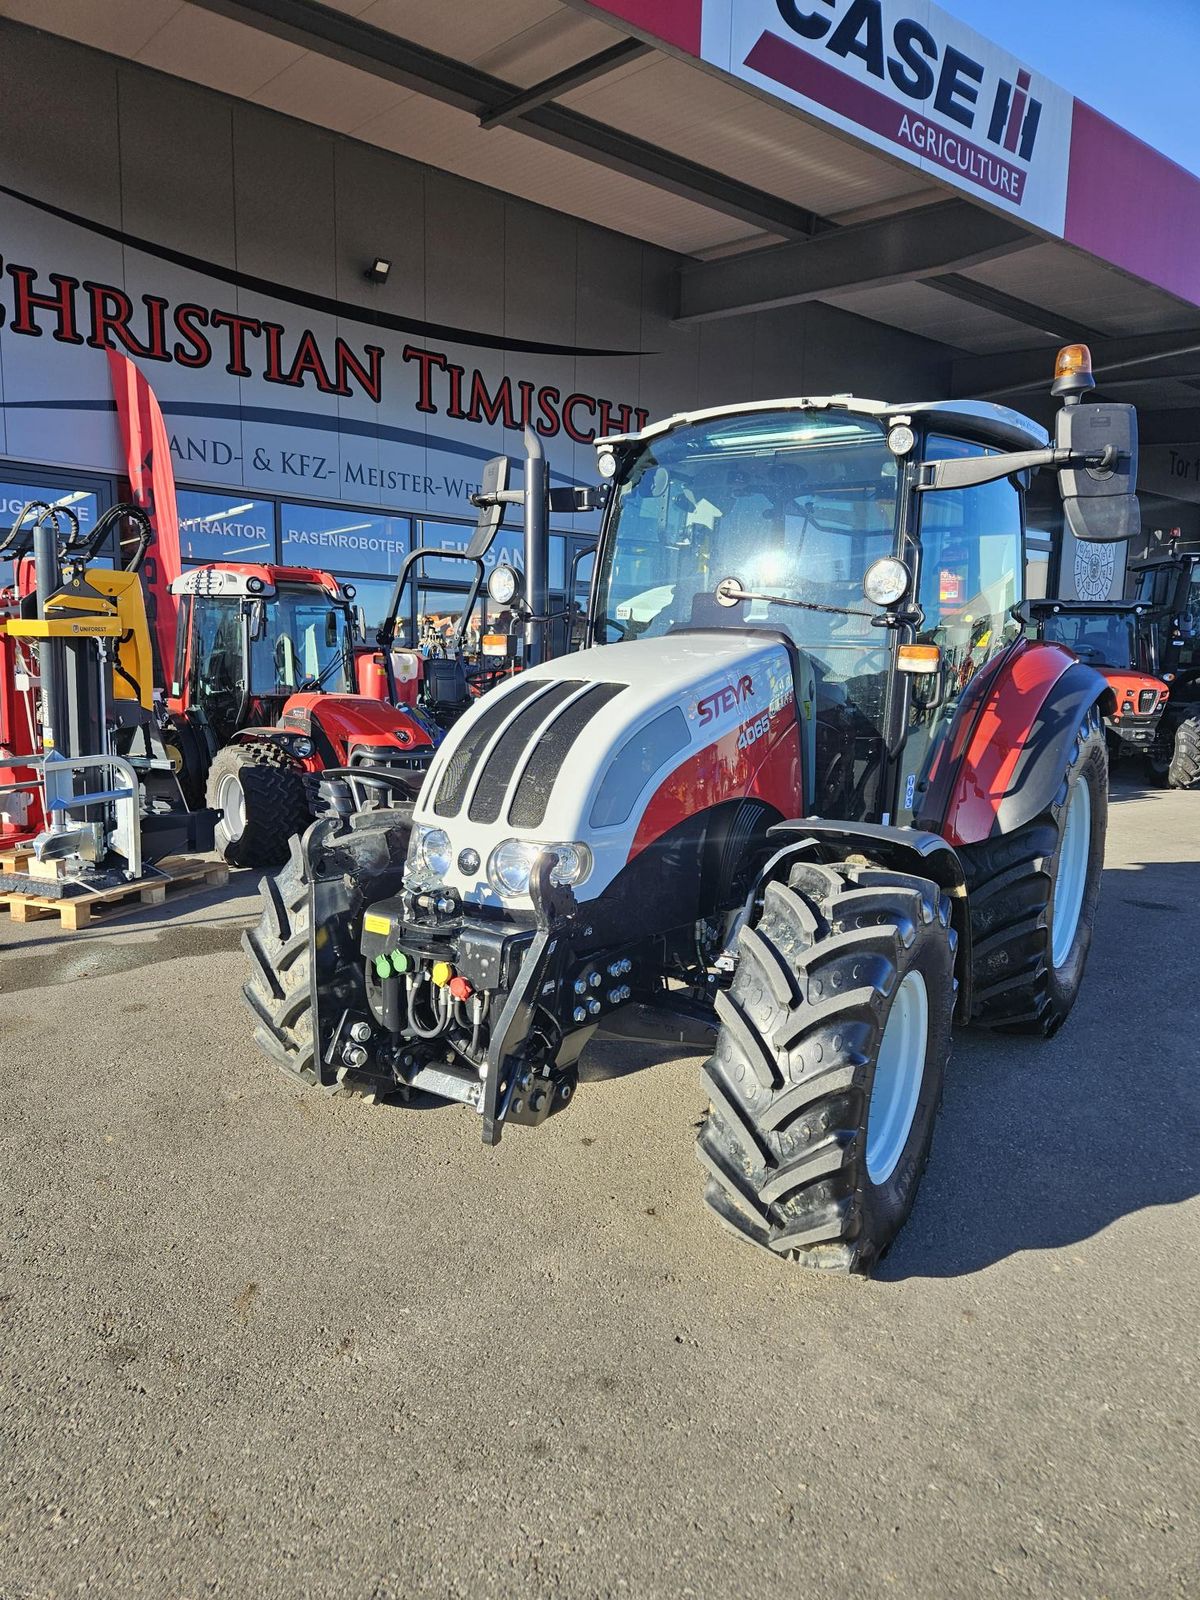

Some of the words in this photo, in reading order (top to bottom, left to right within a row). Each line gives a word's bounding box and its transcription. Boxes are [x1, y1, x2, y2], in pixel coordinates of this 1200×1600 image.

[898, 113, 1020, 198] AGRICULTURE
[0, 253, 385, 403] HRISTIAN
[169, 435, 243, 466] AND-
[252, 447, 274, 472] &
[280, 450, 336, 480] KFZ-
[1169, 450, 1191, 479] Tor
[288, 529, 405, 554] RASENROBOTER
[696, 674, 755, 728] STEYR
[737, 713, 771, 750] 4065
